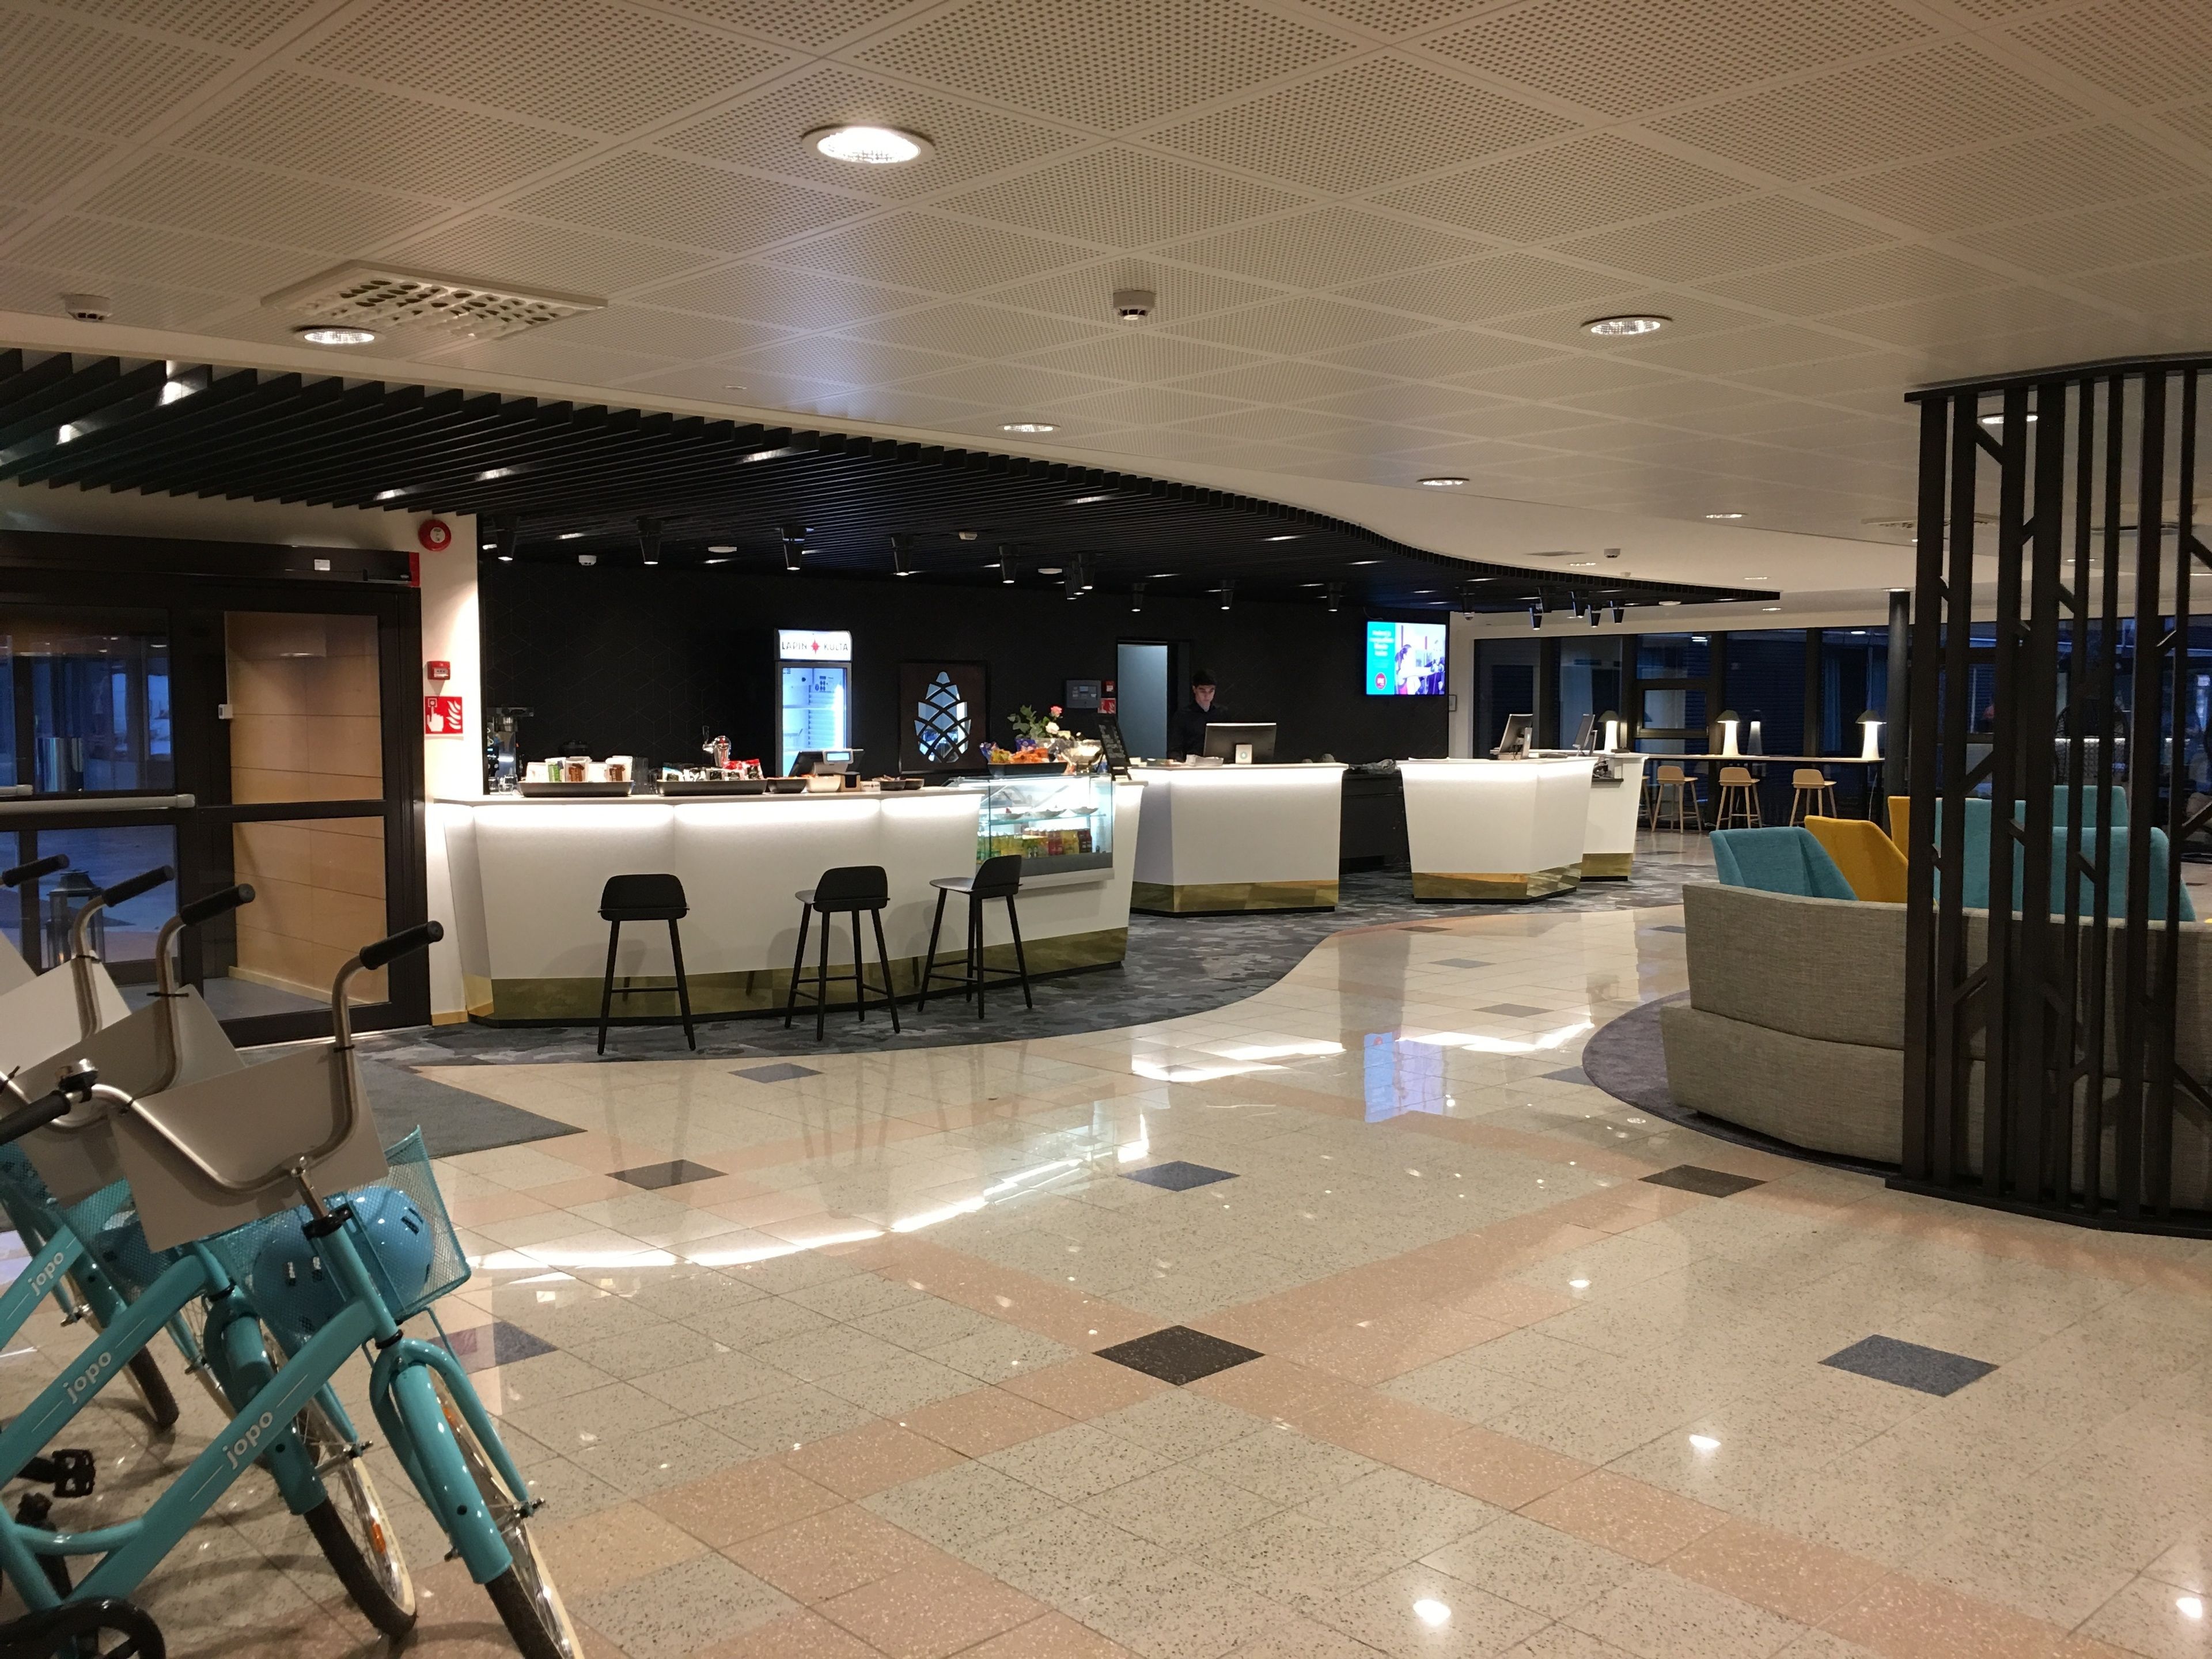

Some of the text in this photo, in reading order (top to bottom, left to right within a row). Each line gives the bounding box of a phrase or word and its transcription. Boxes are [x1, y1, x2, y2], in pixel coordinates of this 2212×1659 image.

[782, 642, 848, 651] LAPIN KULTA
[28, 1252, 64, 1296] jopo
[63, 1351, 112, 1404] jopo
[222, 1411, 273, 1470] jopo
